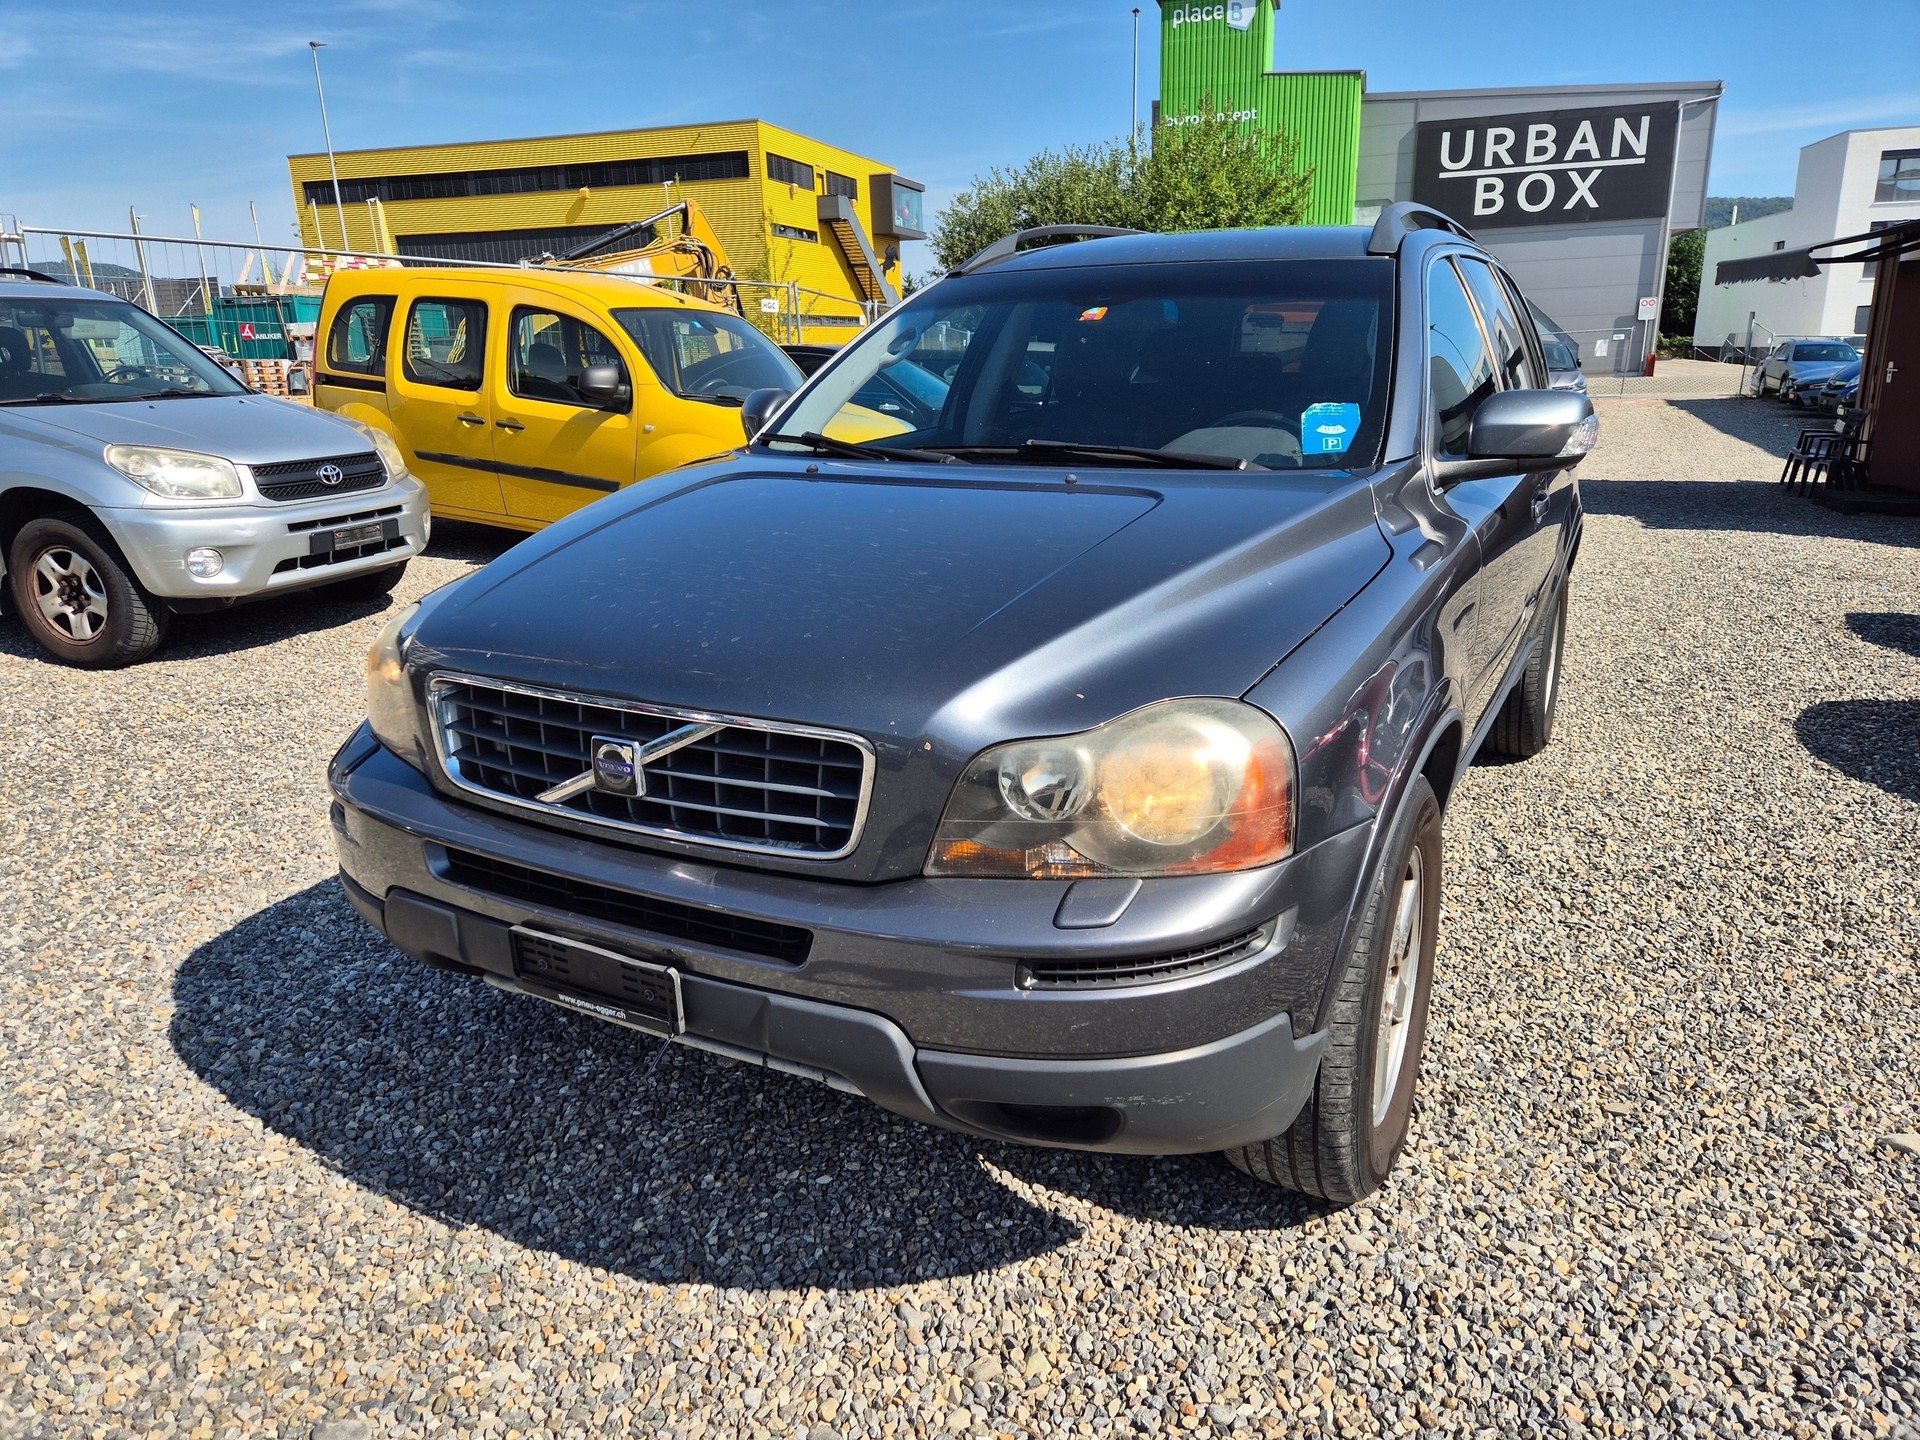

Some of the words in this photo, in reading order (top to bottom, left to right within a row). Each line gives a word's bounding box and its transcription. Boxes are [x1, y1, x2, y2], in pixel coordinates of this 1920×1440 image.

[1172, 3, 1224, 29] place
[1440, 115, 1650, 170] URBAN
[1473, 169, 1603, 216] BOX
[762, 302, 777, 310] HGC
[1328, 439, 1338, 449] P
[558, 993, 626, 1020] www.pneu-egger.ch
